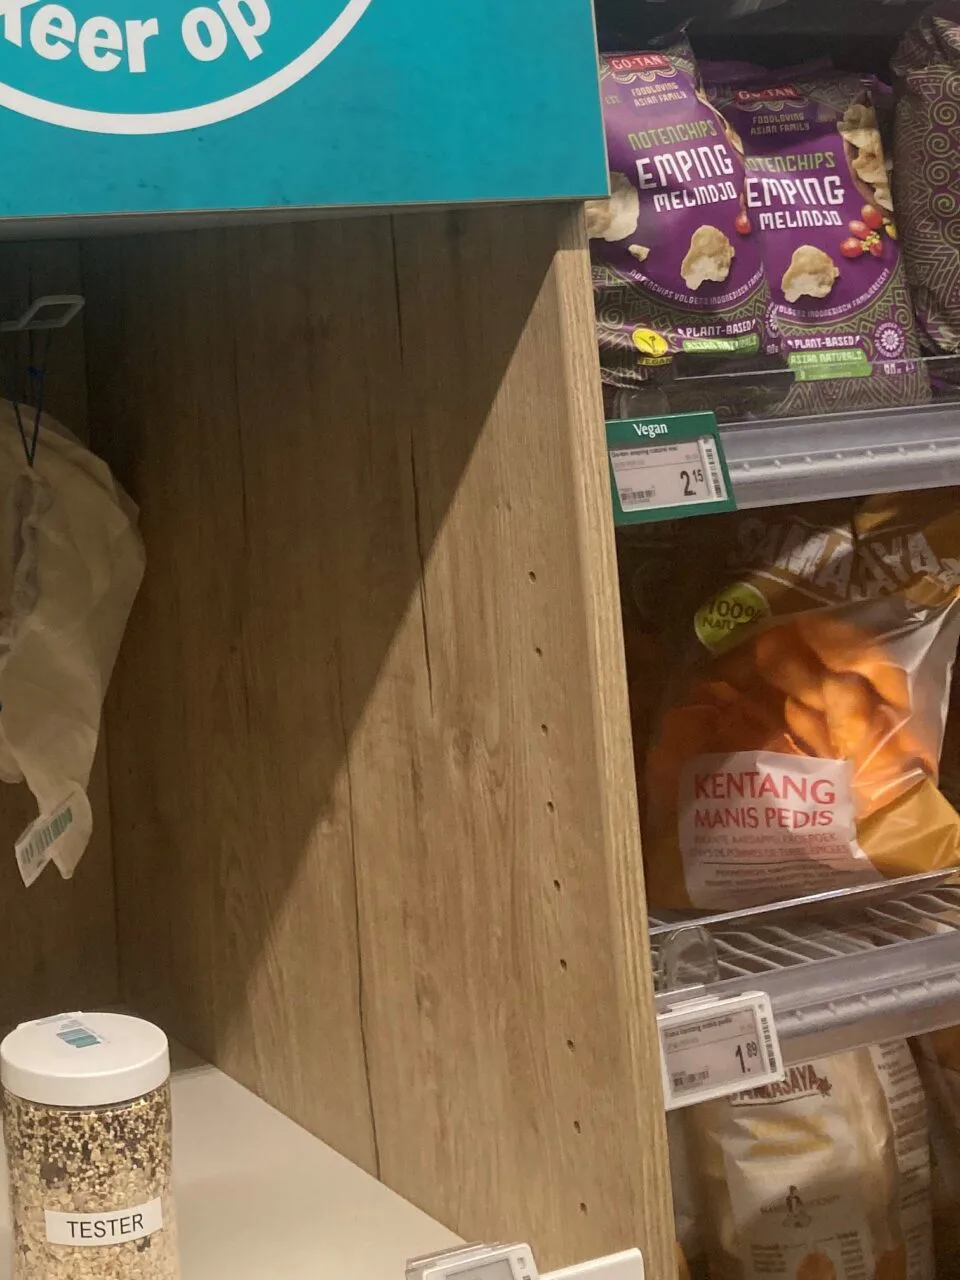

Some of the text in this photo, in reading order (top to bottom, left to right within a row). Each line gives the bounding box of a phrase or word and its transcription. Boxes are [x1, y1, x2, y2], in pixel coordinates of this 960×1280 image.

[628, 120, 718, 151] NOTENCHIPS
[635, 144, 734, 190] EMPING
[653, 181, 738, 213] MELINDJO
[746, 175, 845, 208] EMPING
[759, 210, 843, 231] MELINDJO
[633, 422, 669, 439] Vegan
[695, 770, 837, 805] KENTANG
[694, 806, 834, 830] MANIS PEDIS
[66, 1213, 145, 1241] TESTER
